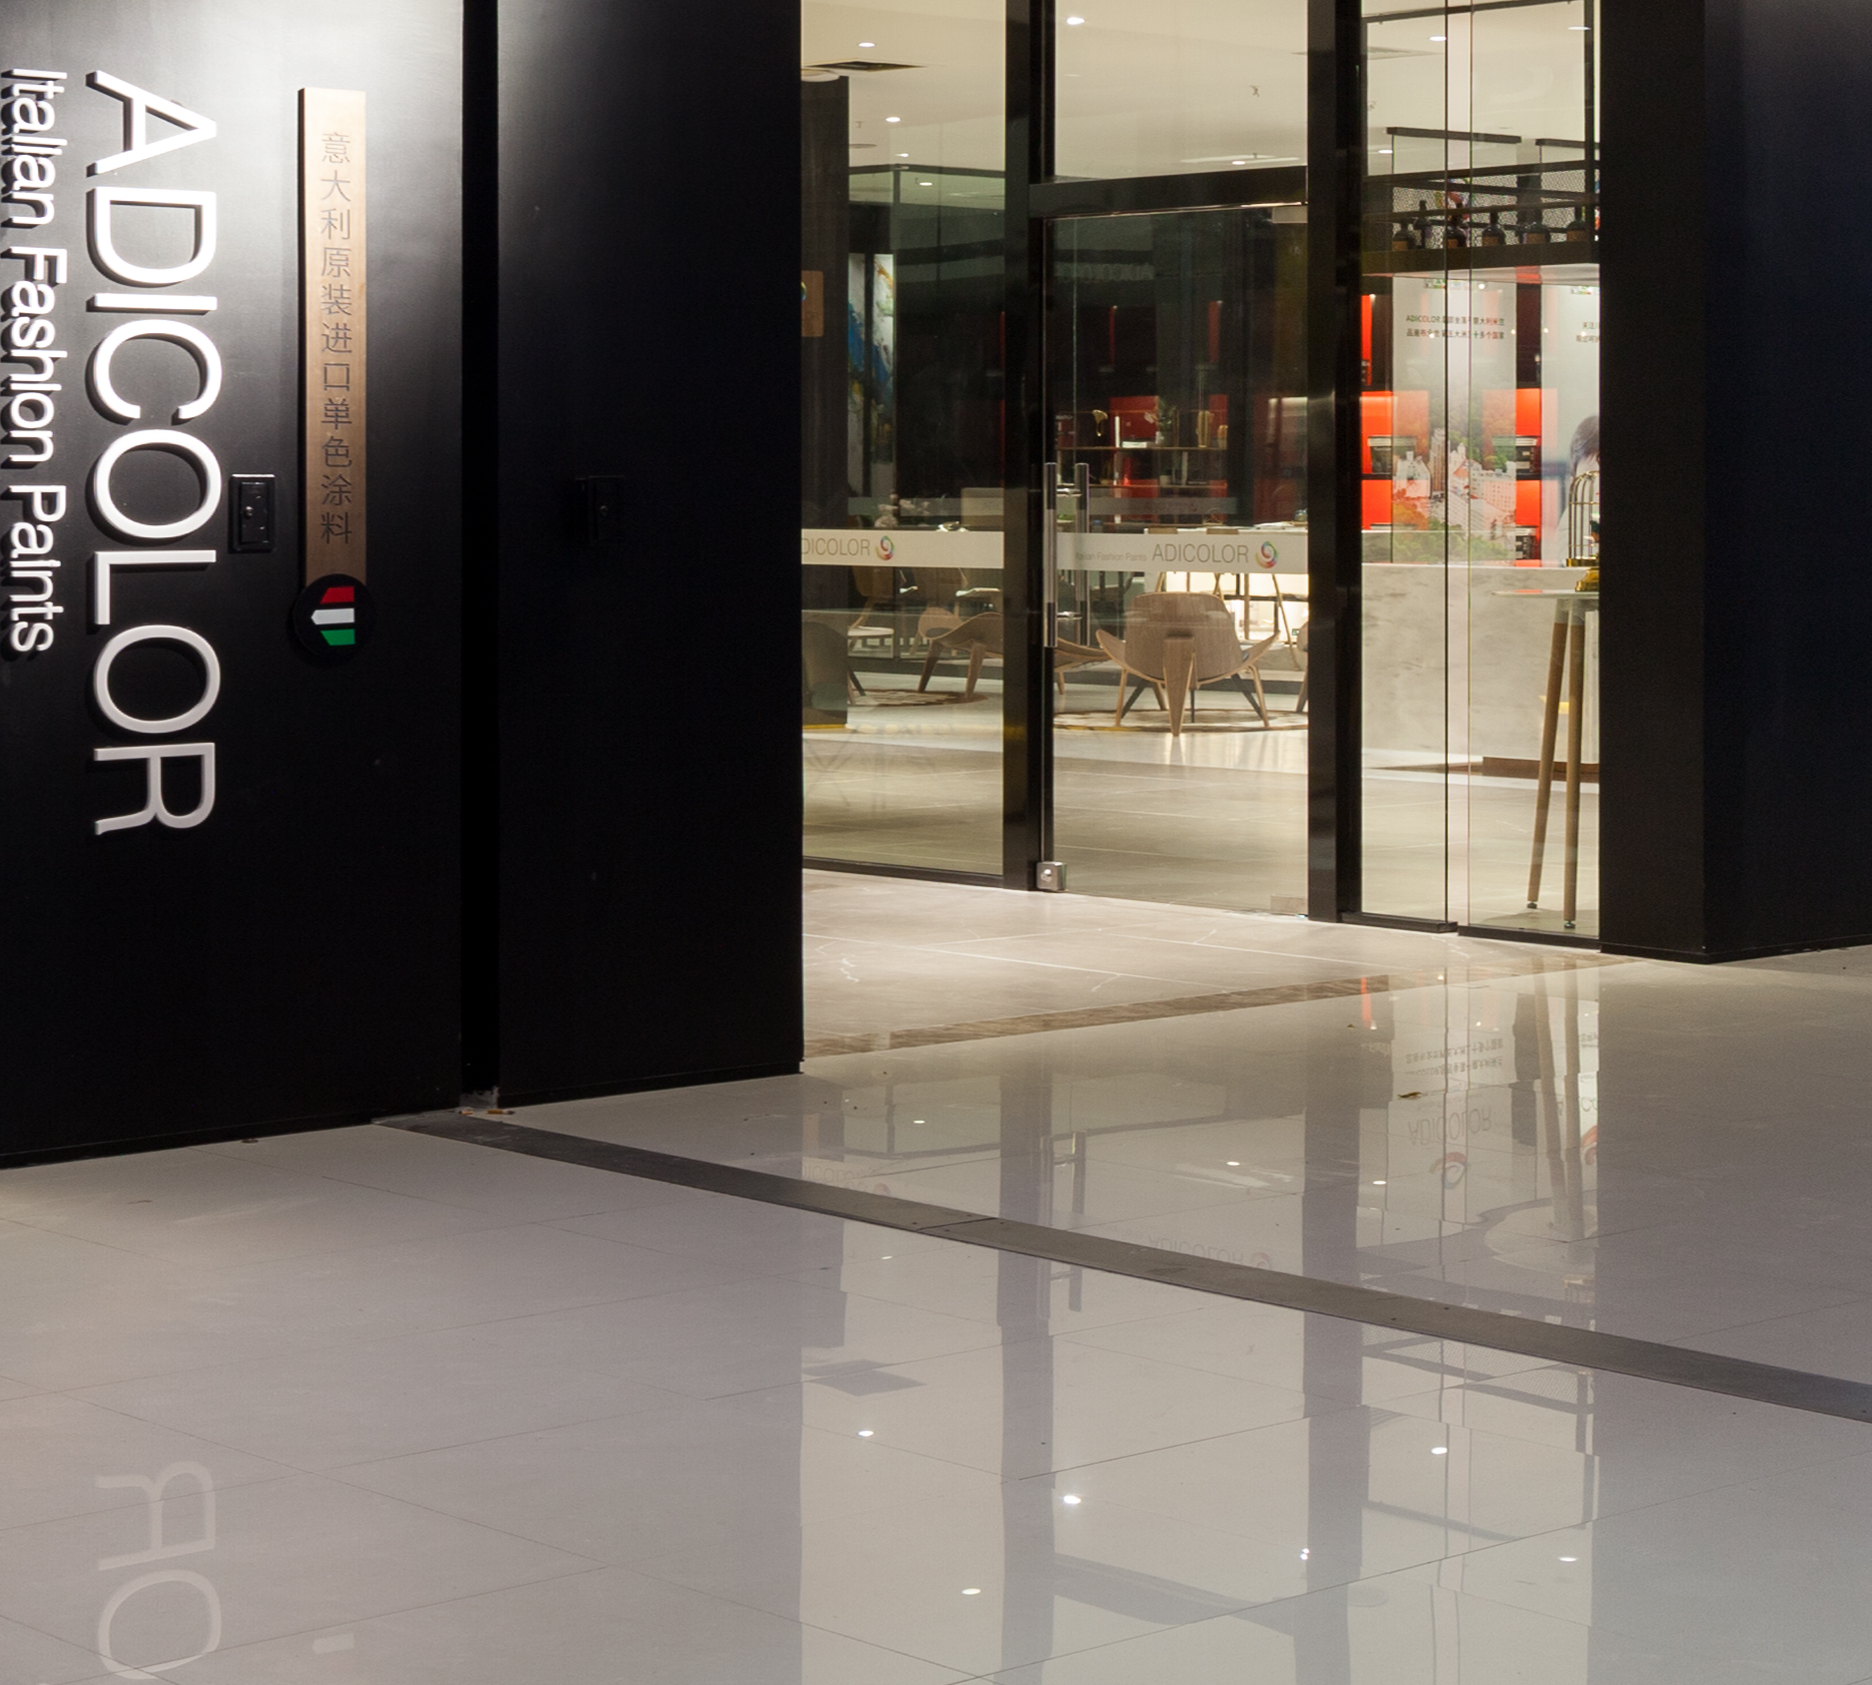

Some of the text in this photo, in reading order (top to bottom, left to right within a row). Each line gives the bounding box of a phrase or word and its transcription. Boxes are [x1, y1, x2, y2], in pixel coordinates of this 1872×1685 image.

[8, 69, 68, 654] Italian Fashion Paints
[92, 69, 223, 836] ADICOLOR
[319, 130, 353, 546] 意大利原装进口单色涂料
[801, 537, 871, 557] DICOLOR
[1152, 543, 1250, 564] ADICOLOR
